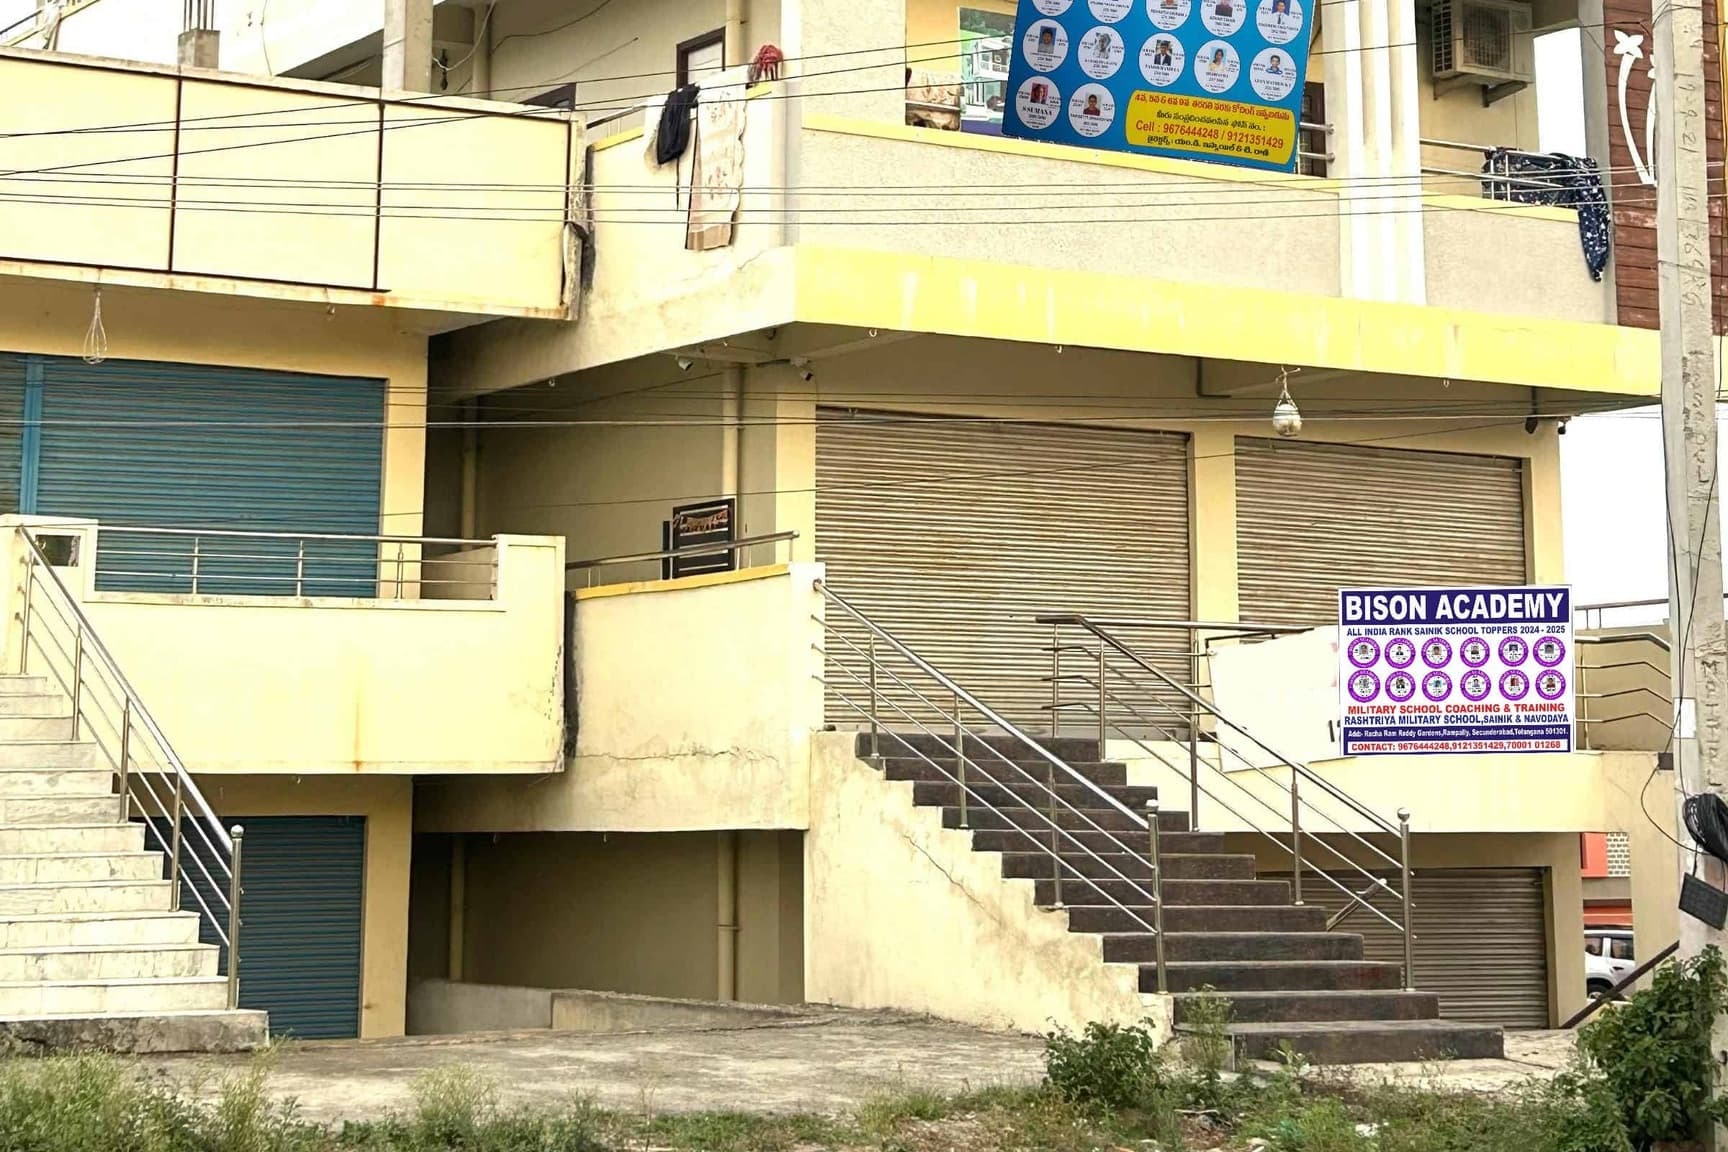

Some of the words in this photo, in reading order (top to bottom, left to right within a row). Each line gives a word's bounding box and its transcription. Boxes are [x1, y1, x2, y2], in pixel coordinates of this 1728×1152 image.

[1136, 119, 1154, 132] Cell
[1163, 123, 1219, 139] 9676444248
[1227, 131, 1284, 149] 9121351429
[1346, 595, 1427, 621] BISON
[1435, 593, 1564, 620] ACADEMY
[1347, 628, 1362, 636] ALL
[1365, 628, 1387, 636] INDIA
[1389, 627, 1412, 635] RANK
[1414, 627, 1443, 635] SAINIK
[1445, 626, 1478, 635] SCHOOL
[1481, 626, 1518, 634] TOPPERS
[1520, 626, 1539, 634] 2024
[1546, 625, 1565, 634] 2025
[1348, 705, 1396, 714] MILITARY
[1400, 705, 1442, 714] SCHOOL
[1445, 704, 1503, 713] COACHING
[1504, 703, 1510, 712] &
[1514, 703, 1565, 713] TRAINING
[1344, 715, 1396, 725] RASHTRIYA
[1399, 715, 1441, 724] MILITARY
[1515, 714, 1521, 723] &
[1524, 714, 1568, 723] NAVODAYA
[1398, 729, 1416, 738] Reddy
[1351, 743, 1395, 751] CONTACT:
